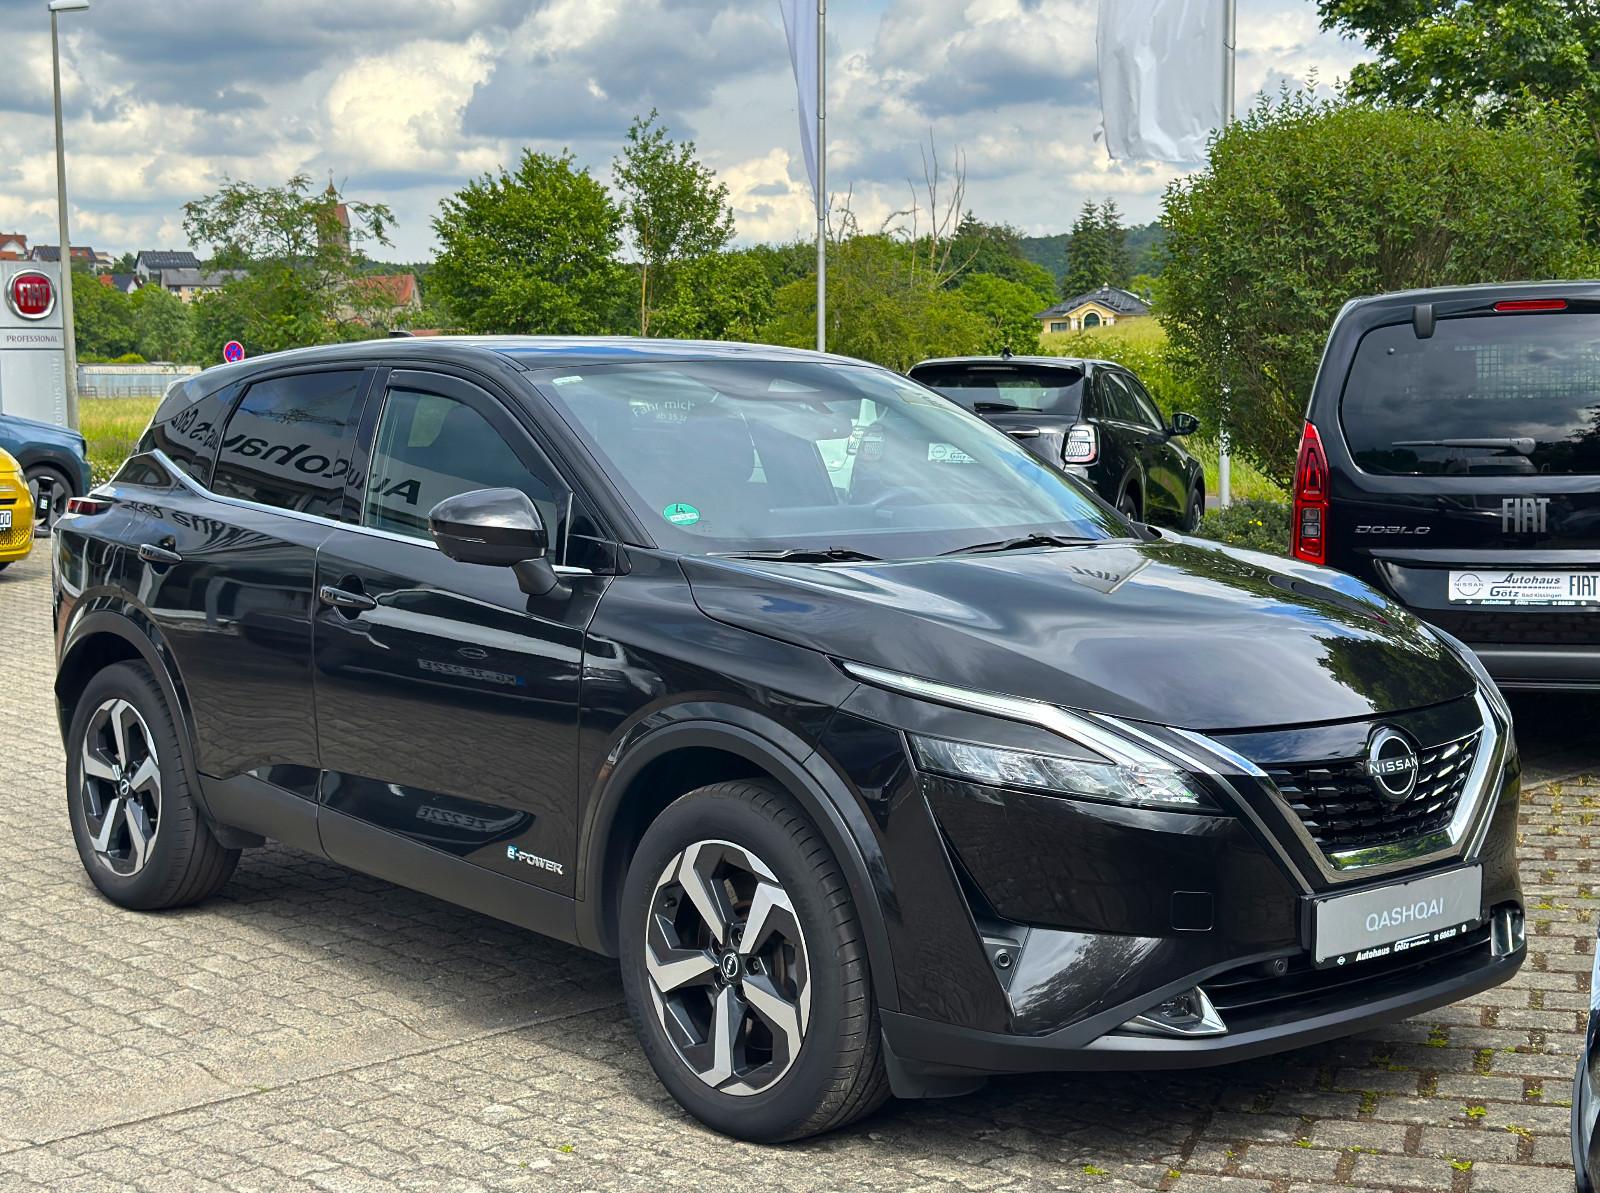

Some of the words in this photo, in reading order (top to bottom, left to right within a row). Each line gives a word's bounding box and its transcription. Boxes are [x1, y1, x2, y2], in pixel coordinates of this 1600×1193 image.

[18, 283, 49, 307] FIAT
[6, 335, 58, 343] PROFESSIONAL
[675, 503, 686, 514] 4
[1502, 498, 1550, 533] FIAT
[1354, 525, 1431, 535] DOBLO
[1490, 586, 1519, 598] Götz
[1499, 573, 1561, 585] Autohaus
[1569, 575, 1600, 597] FIAT
[1369, 757, 1418, 774] NISSAN
[1365, 897, 1444, 932] QASHQAI
[1356, 946, 1390, 962] Autohaus
